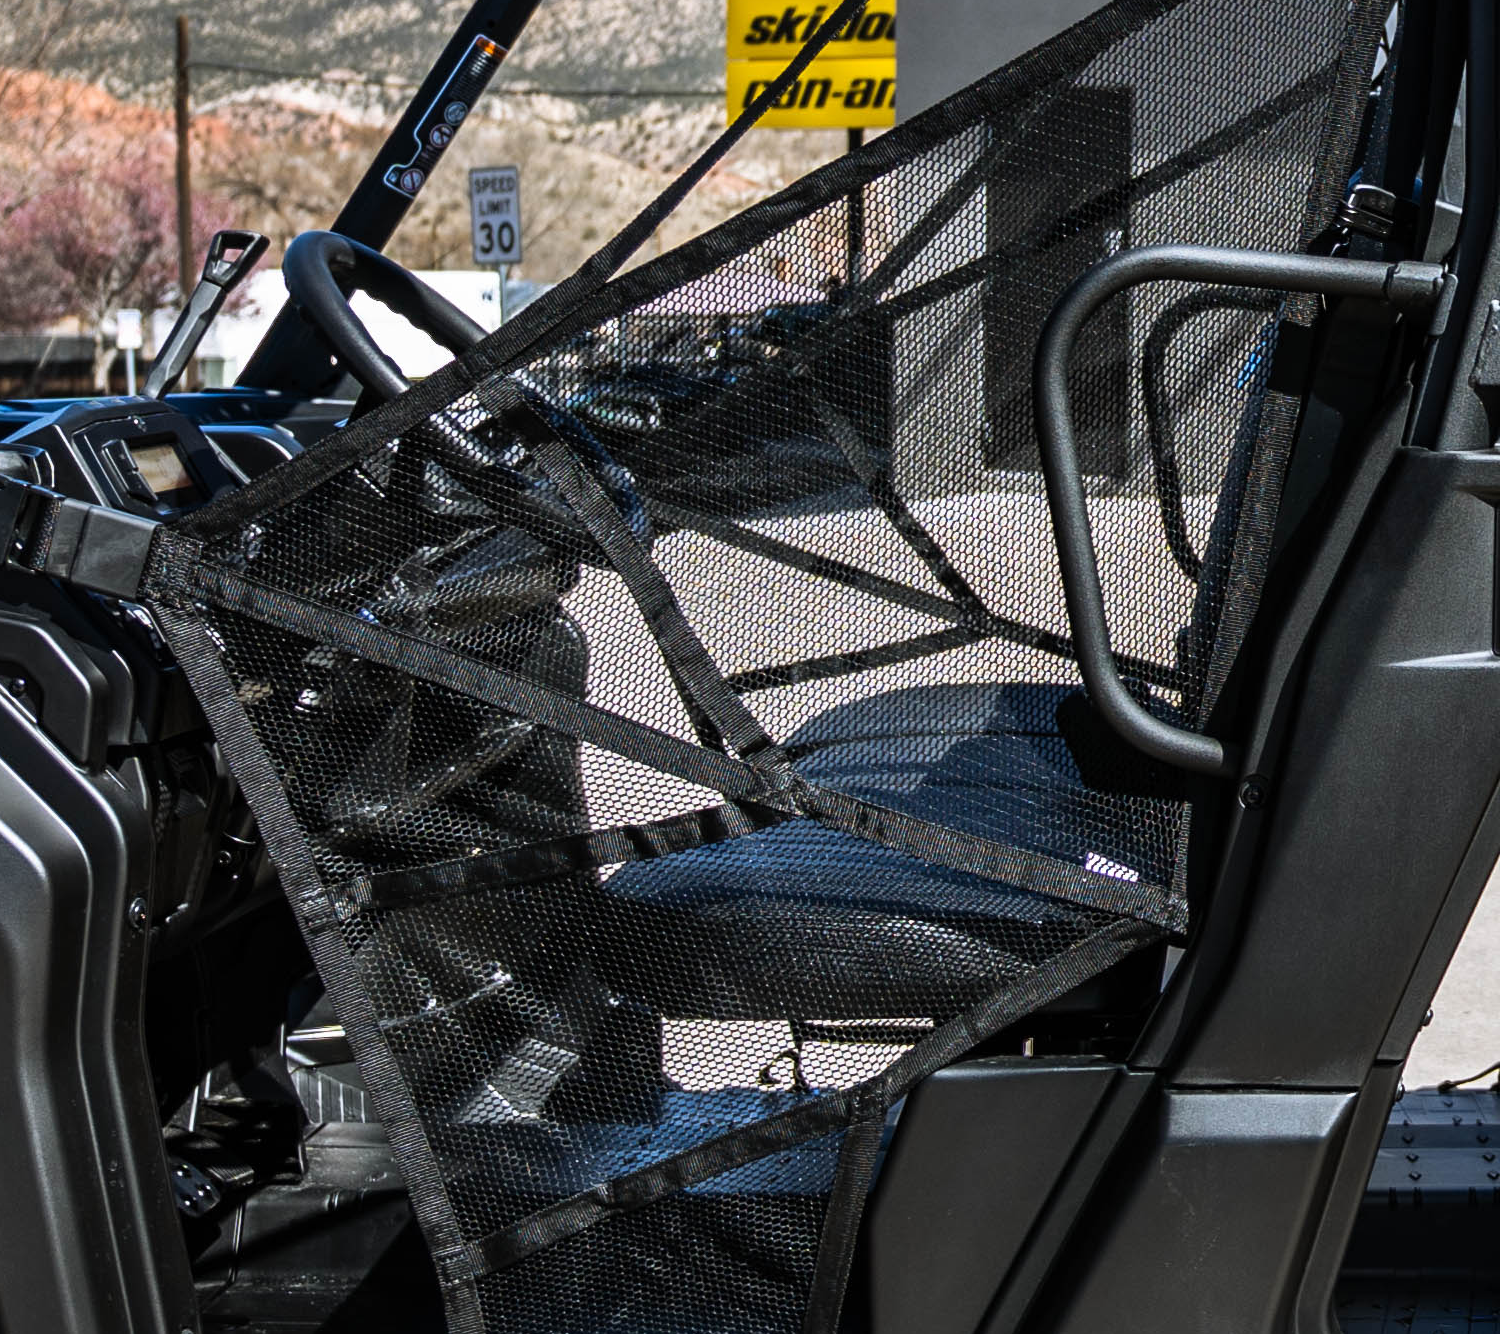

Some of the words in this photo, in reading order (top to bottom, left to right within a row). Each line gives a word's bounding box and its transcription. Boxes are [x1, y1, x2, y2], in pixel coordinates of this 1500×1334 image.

[474, 176, 516, 195] SPEED
[478, 197, 511, 216] LIMIT
[479, 220, 515, 255] 30
